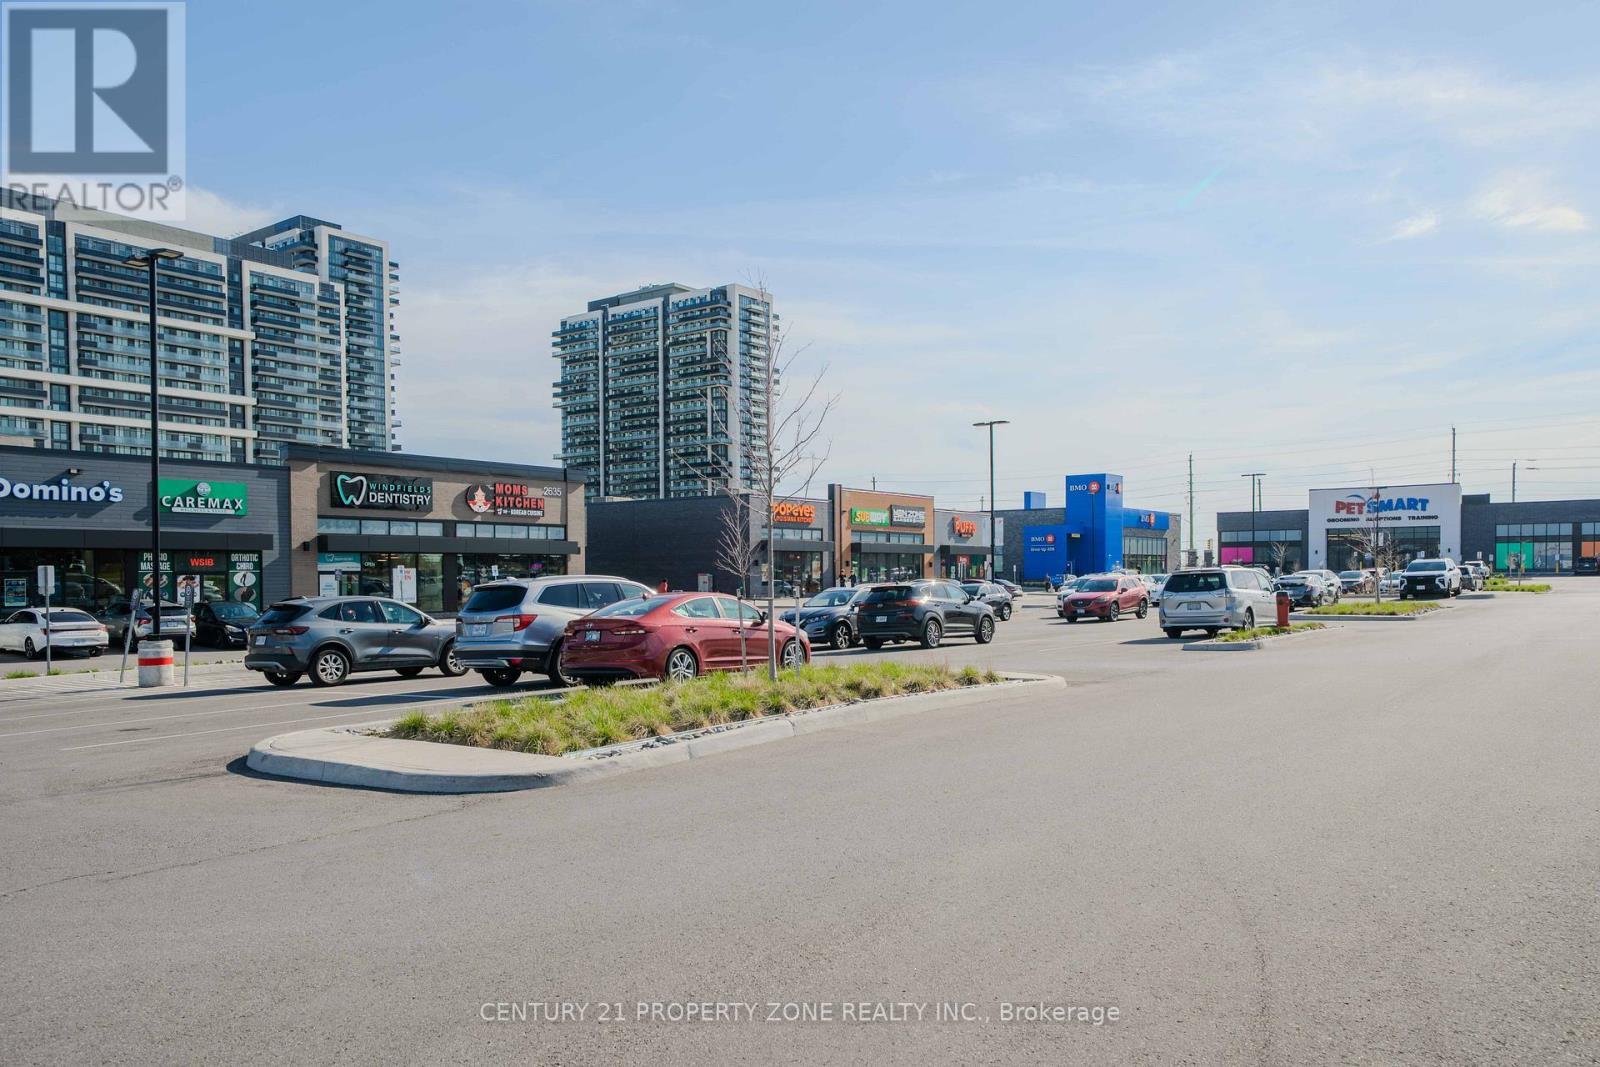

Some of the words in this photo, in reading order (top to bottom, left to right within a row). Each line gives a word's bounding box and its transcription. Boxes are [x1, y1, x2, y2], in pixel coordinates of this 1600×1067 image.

[369, 482, 431, 494] WINDFIELDS
[495, 483, 529, 496] MOMS
[543, 486, 562, 497] 2635
[1069, 484, 1088, 492] BMO
[161, 495, 244, 510] CAREMAX
[369, 491, 431, 505] DENTISTRY
[495, 496, 545, 510] KITCHEN
[855, 511, 886, 524] SUBWAY
[143, 552, 168, 561] PHIO
[189, 557, 215, 567] WSIB
[230, 553, 259, 562] ORTHOTIC
[140, 562, 171, 570] MASAGE
[236, 562, 254, 570] CHIRO
